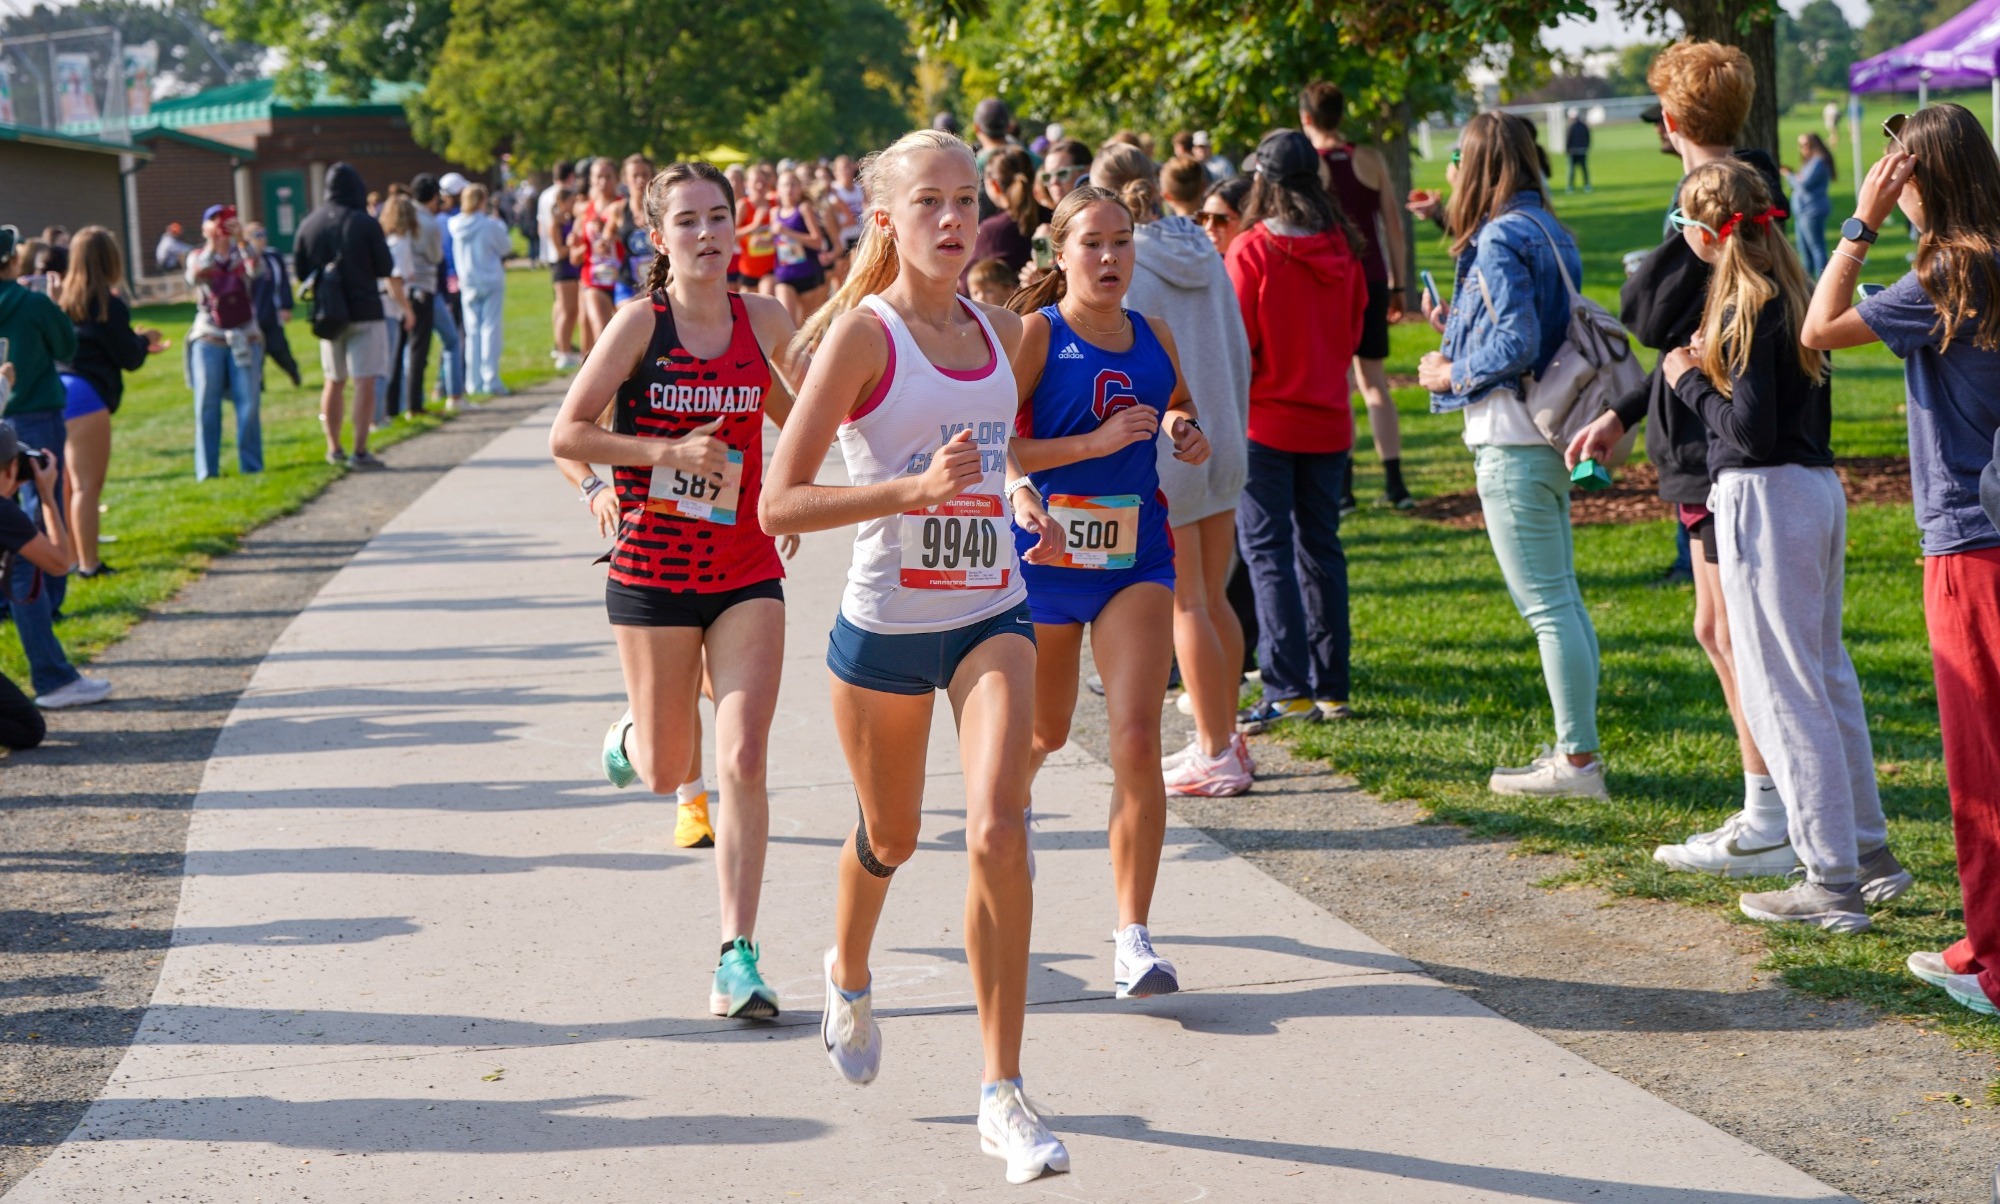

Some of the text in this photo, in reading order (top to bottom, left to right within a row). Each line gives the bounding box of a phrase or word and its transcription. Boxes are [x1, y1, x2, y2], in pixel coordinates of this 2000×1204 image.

[1058, 352, 1085, 360] adidas
[649, 383, 761, 413] CORONADO
[946, 499, 991, 508] Runners Roost
[922, 517, 997, 568] 9940
[1068, 520, 1119, 549] 500
